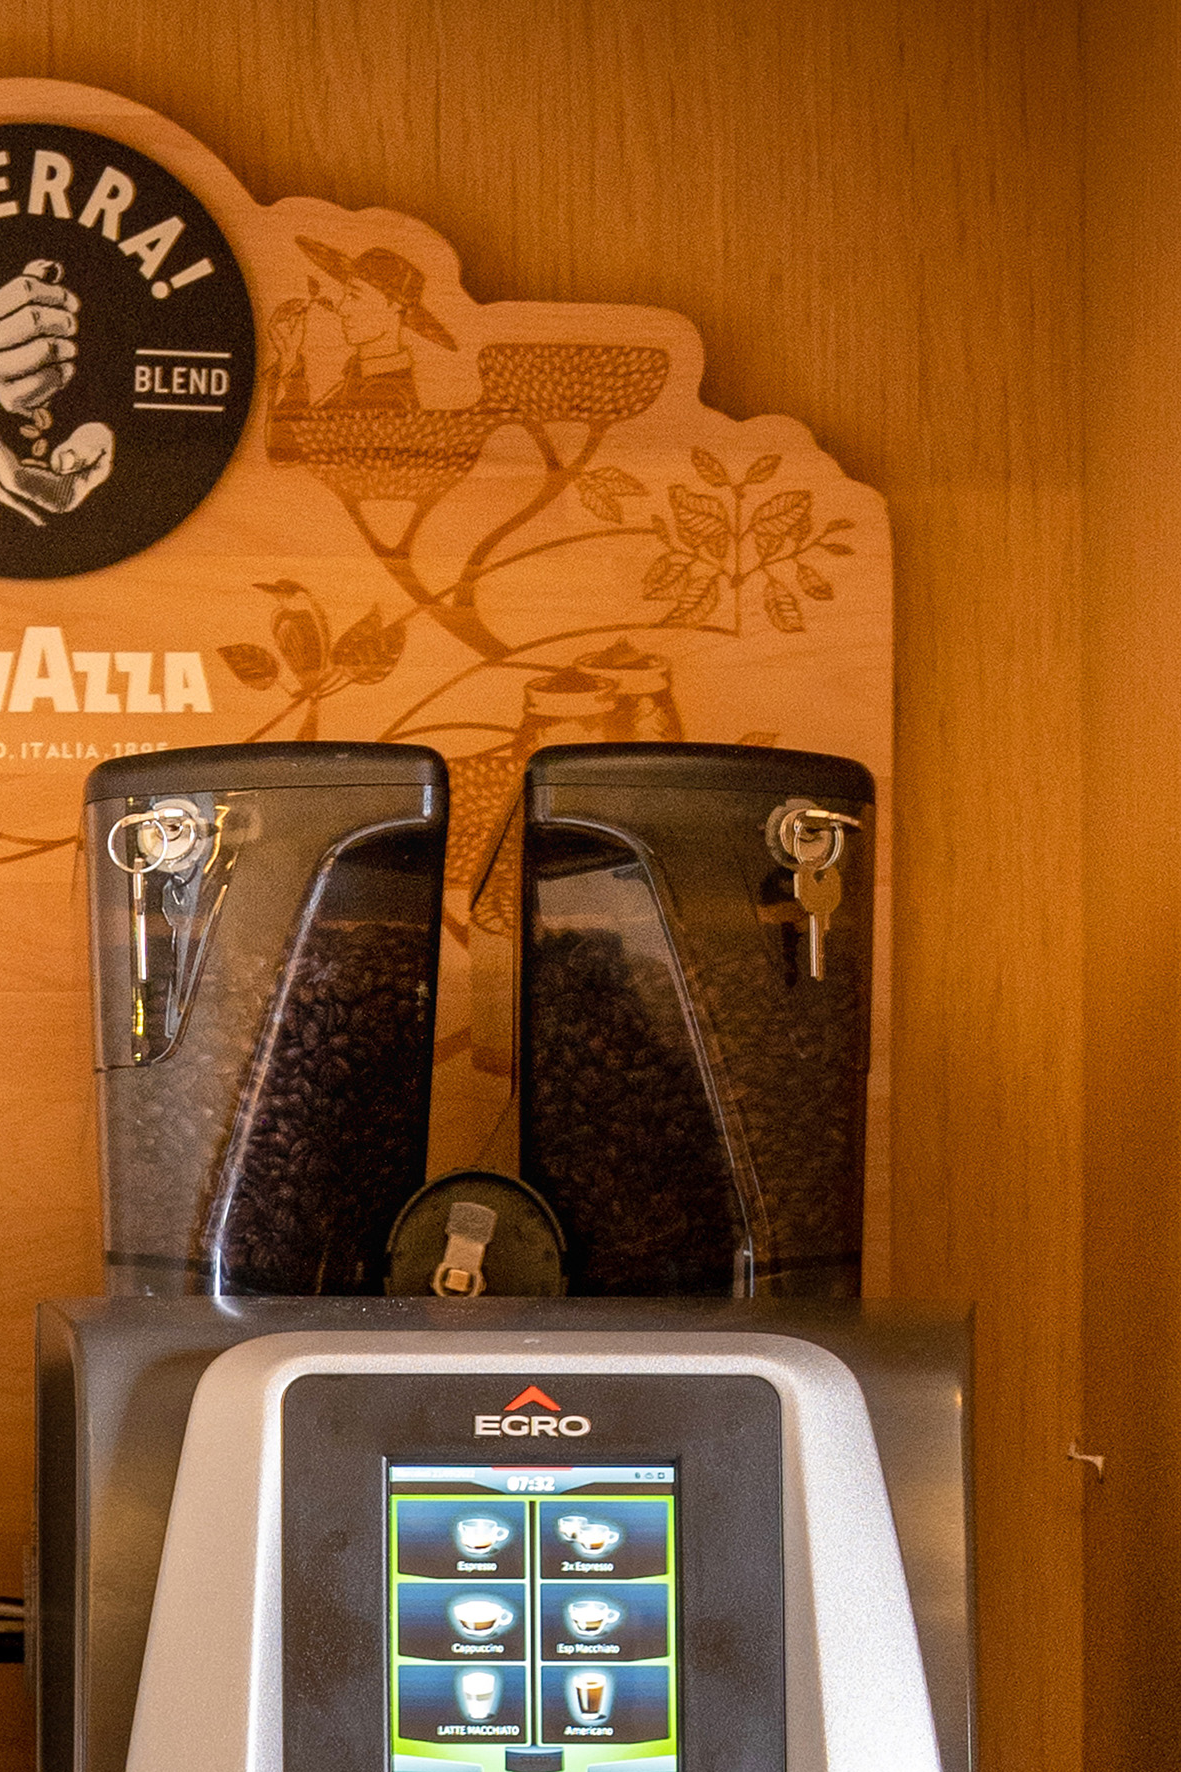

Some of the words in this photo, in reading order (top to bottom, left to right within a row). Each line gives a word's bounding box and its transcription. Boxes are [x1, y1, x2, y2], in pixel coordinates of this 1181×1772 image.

[134, 365, 231, 397] BLEND
[474, 1414, 592, 1437] EGRO
[456, 1560, 498, 1574] Espresso
[561, 1561, 575, 1573] 2x
[575, 1561, 614, 1574] Espresso
[451, 1642, 505, 1655] Cappuccino
[557, 1643, 575, 1655] Esp
[576, 1643, 620, 1655] Macchiato
[437, 1725, 466, 1736] LATTE
[467, 1725, 520, 1736] MACCHIATO
[564, 1725, 614, 1736] Americano
